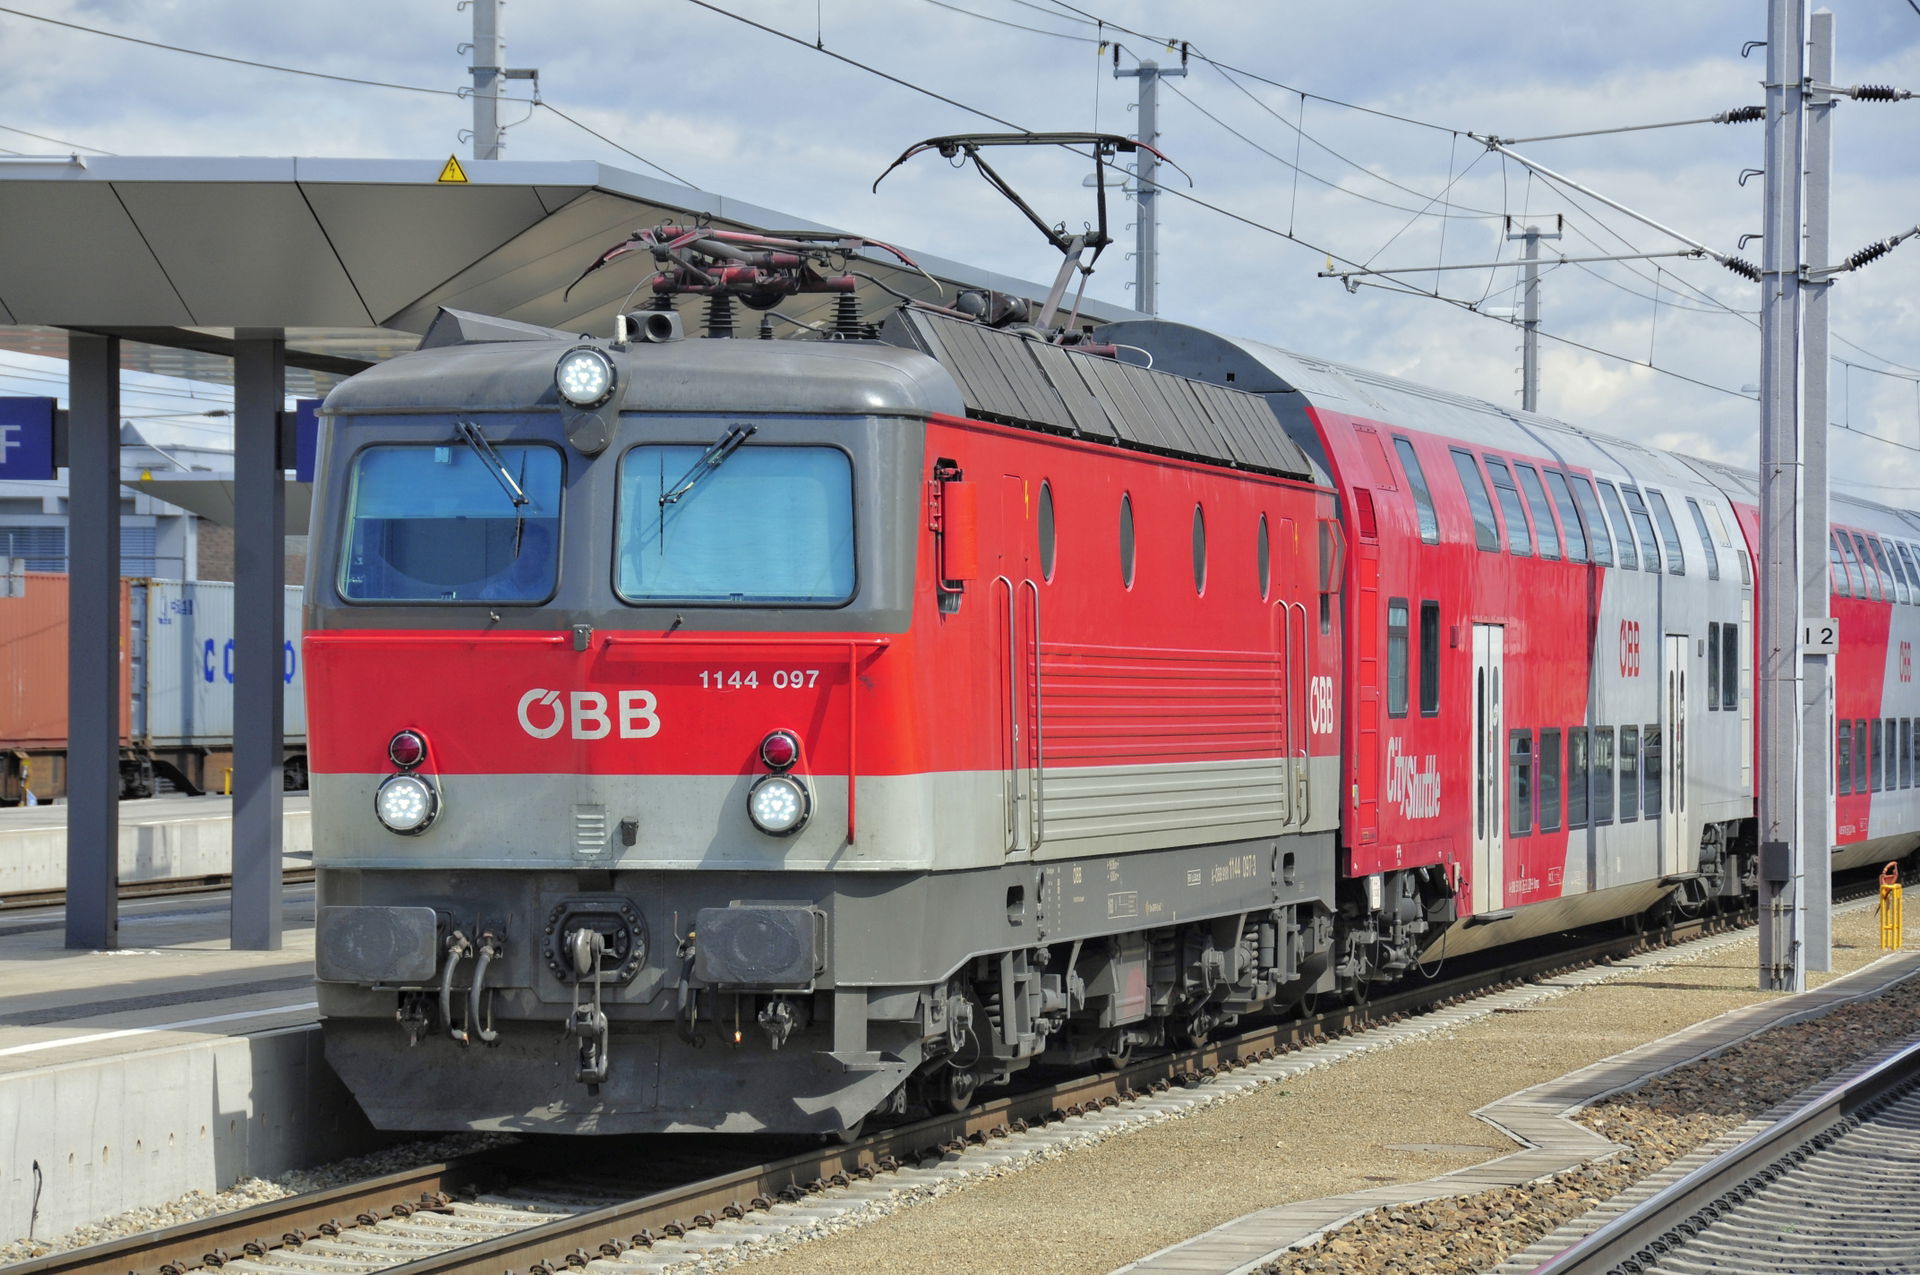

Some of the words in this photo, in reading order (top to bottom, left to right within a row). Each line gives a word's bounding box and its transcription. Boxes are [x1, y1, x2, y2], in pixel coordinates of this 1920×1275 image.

[1620, 619, 1640, 678] ÖBB
[699, 670, 759, 689] 1144
[773, 670, 820, 689] 097
[1310, 676, 1333, 735] ÖBB
[517, 688, 661, 740] ÖBB
